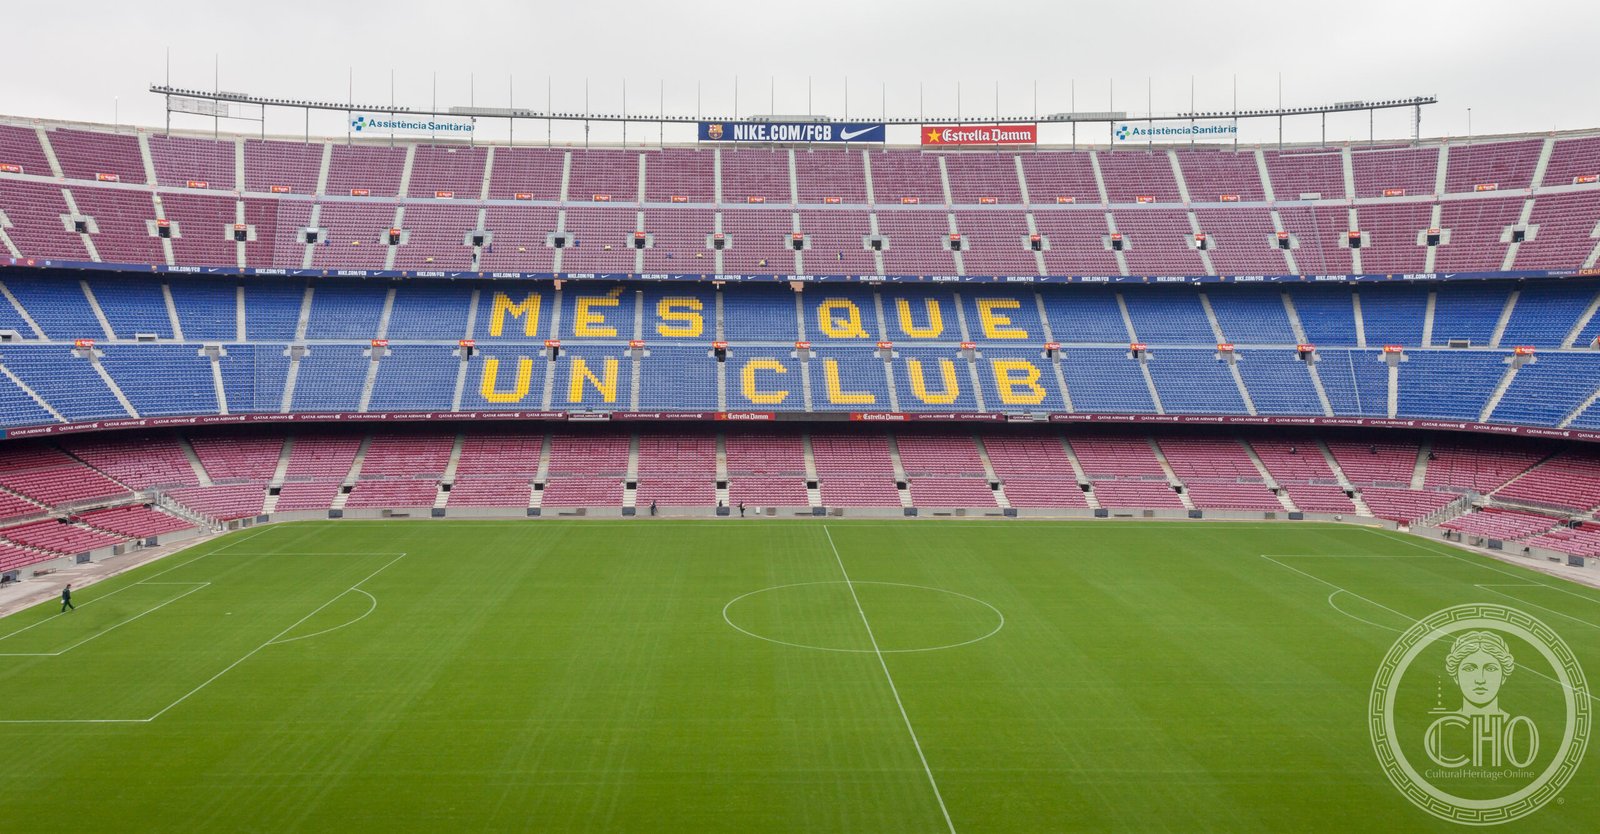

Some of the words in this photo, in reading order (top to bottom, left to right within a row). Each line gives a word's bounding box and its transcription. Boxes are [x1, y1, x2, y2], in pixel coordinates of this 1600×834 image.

[368, 118, 427, 130] Assistència
[428, 121, 471, 132] Sanitària
[733, 124, 832, 141] NIKE.COM/FCB
[1132, 126, 1191, 135] Assistència
[1192, 125, 1237, 134] Sanitària
[942, 128, 990, 142] Estrella
[991, 128, 1031, 142] Damm
[489, 287, 703, 337] MÉS
[818, 298, 1028, 338] QUE
[480, 358, 618, 403] UN
[740, 358, 1047, 404] CLUB
